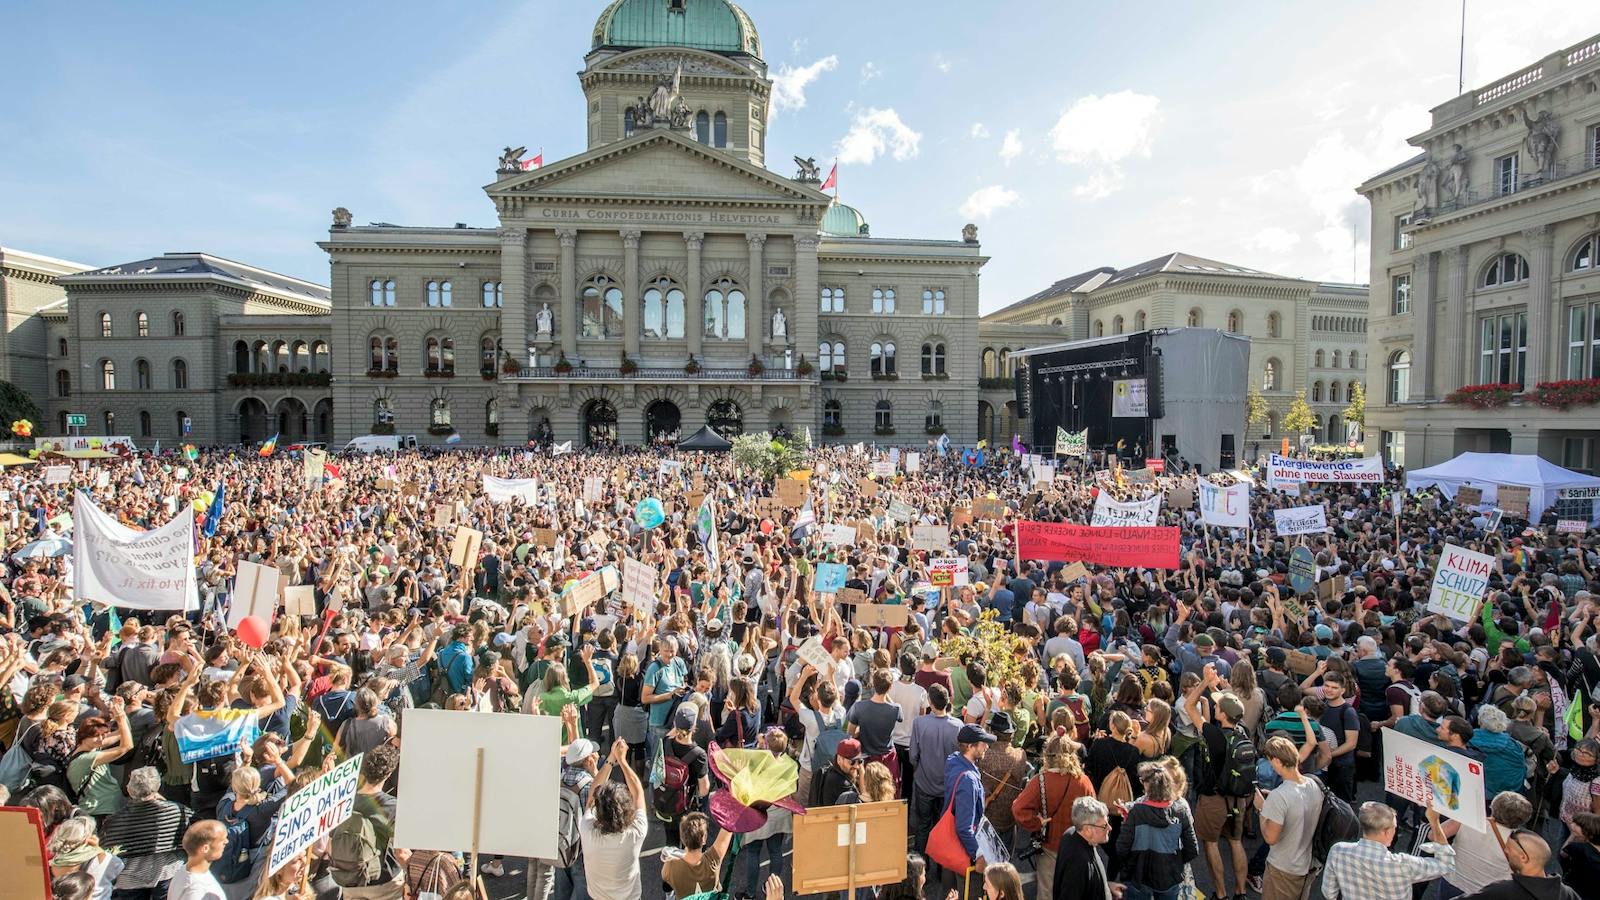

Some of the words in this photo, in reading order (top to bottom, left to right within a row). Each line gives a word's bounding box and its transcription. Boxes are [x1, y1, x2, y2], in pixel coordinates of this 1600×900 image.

[542, 208, 580, 218] CURIA
[587, 209, 703, 221] CONFOEDERATIONIS
[710, 212, 780, 223] HELVETICAE
[1271, 455, 1353, 470] Energiewende
[1274, 468, 1301, 479] ohne
[1304, 472, 1329, 480] neue
[1333, 470, 1381, 481] Stauseen
[1447, 553, 1488, 577] KLIMA
[1437, 569, 1485, 596] SCHUTZ
[1435, 587, 1480, 616] JETZT
[1387, 765, 1395, 791] NEUE
[1395, 755, 1404, 795] ENERGIE
[1405, 763, 1413, 779] DIE
[275, 807, 312, 847] SIND
[272, 837, 299, 868] BLEIBT
[300, 826, 315, 847] DER
